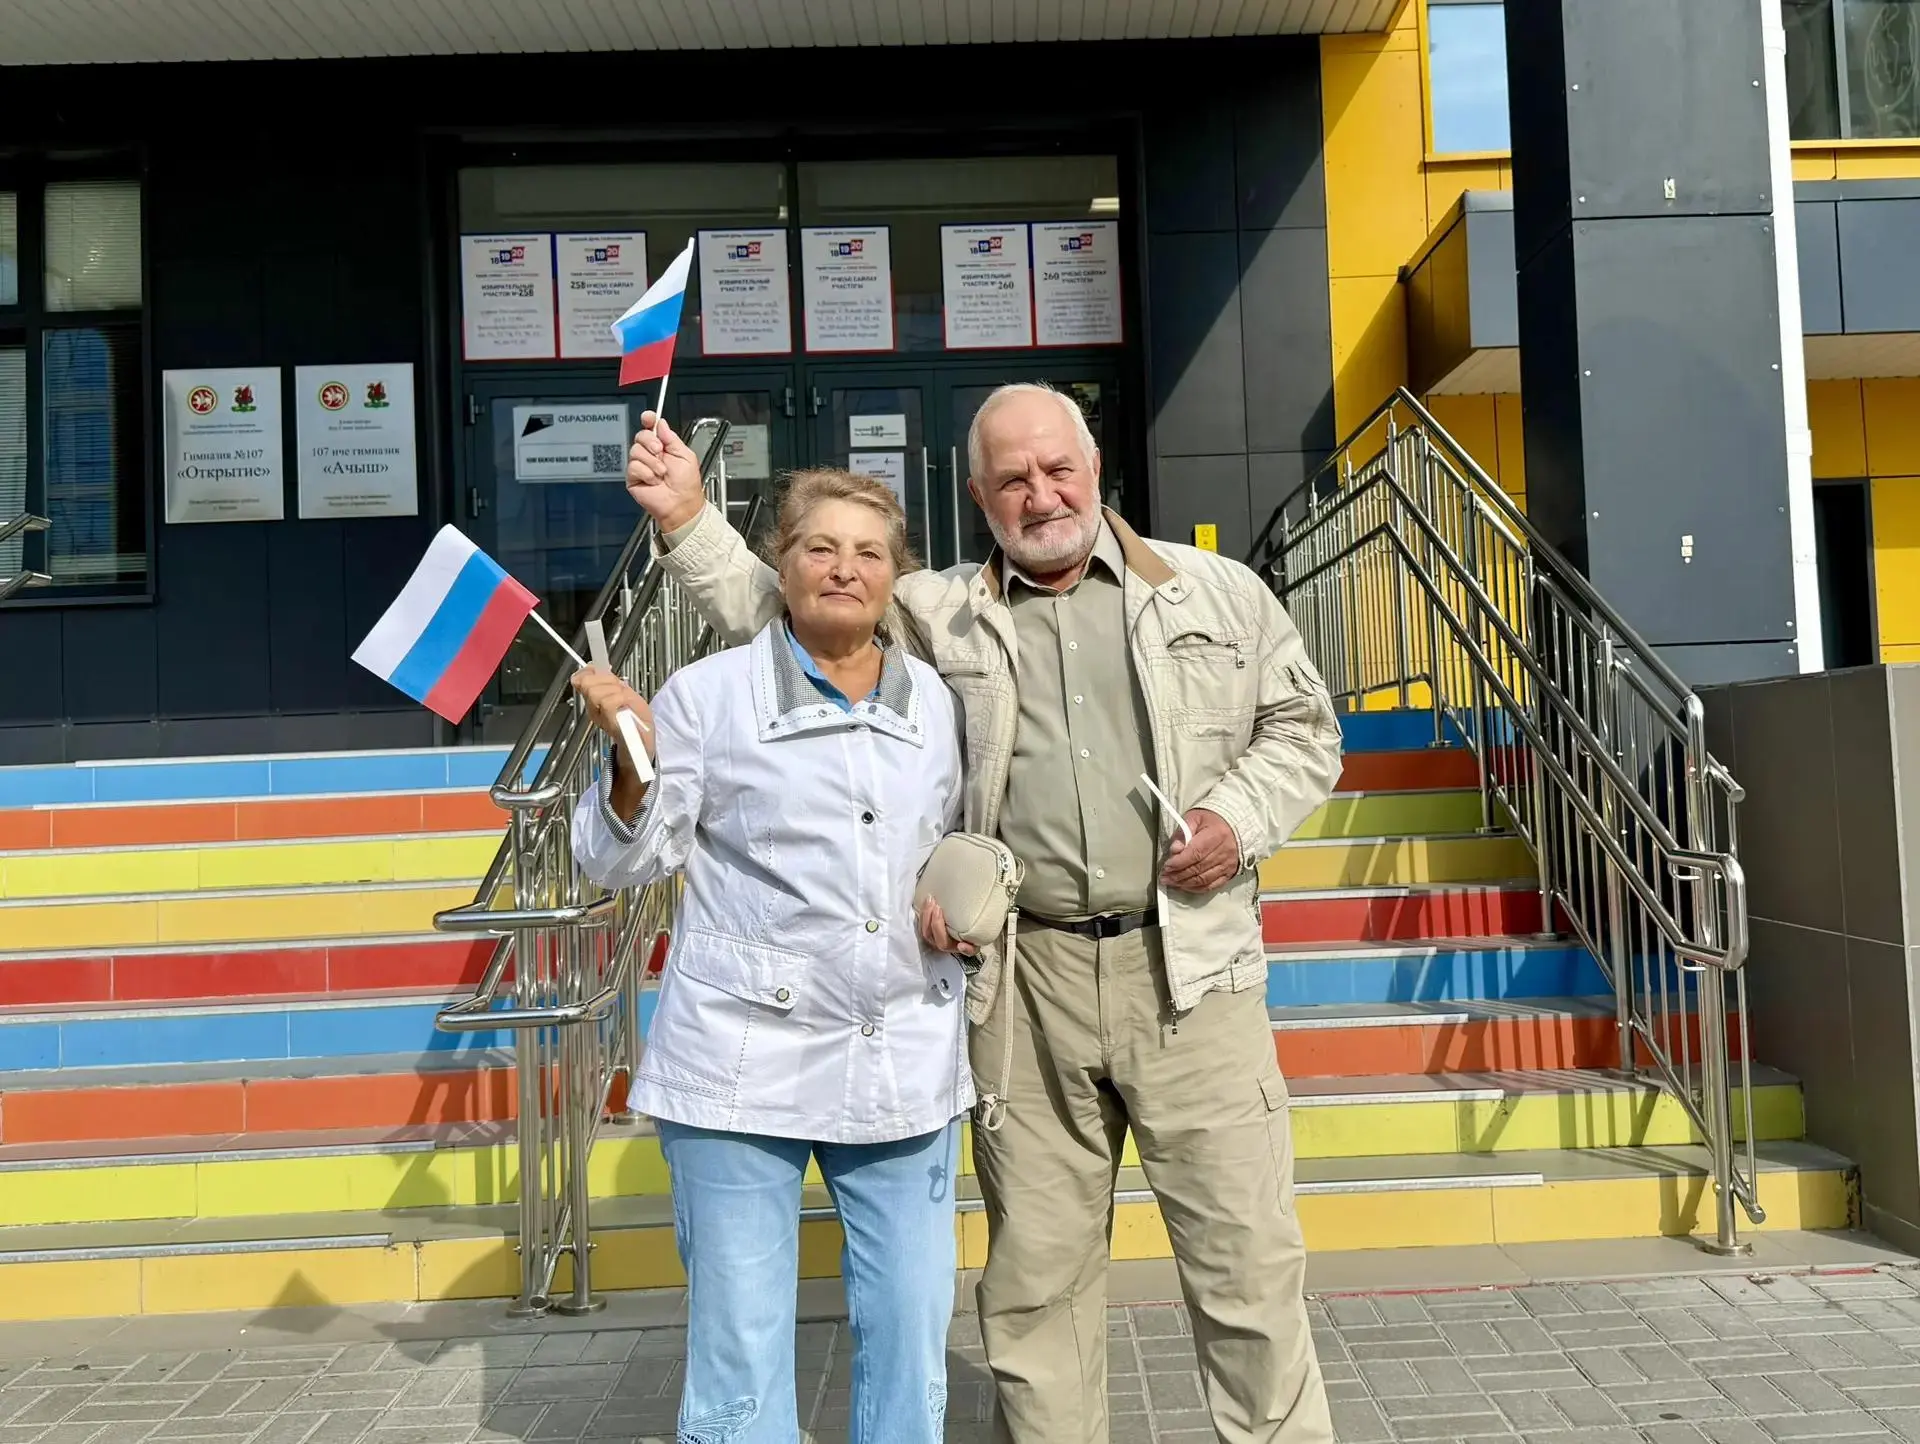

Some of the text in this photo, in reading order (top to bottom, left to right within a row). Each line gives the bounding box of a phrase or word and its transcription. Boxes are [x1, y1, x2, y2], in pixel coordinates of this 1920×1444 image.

[1042, 272, 1060, 281] 260
[997, 281, 1014, 290] 260
[558, 414, 619, 423] ОБРАЗОВАНИЕ
[183, 449, 264, 461] Гимназия №107
[312, 448, 329, 457] 107
[352, 447, 400, 456] гимназия
[177, 464, 271, 482] «Открытие»
[323, 462, 389, 474] «Ачыш»
